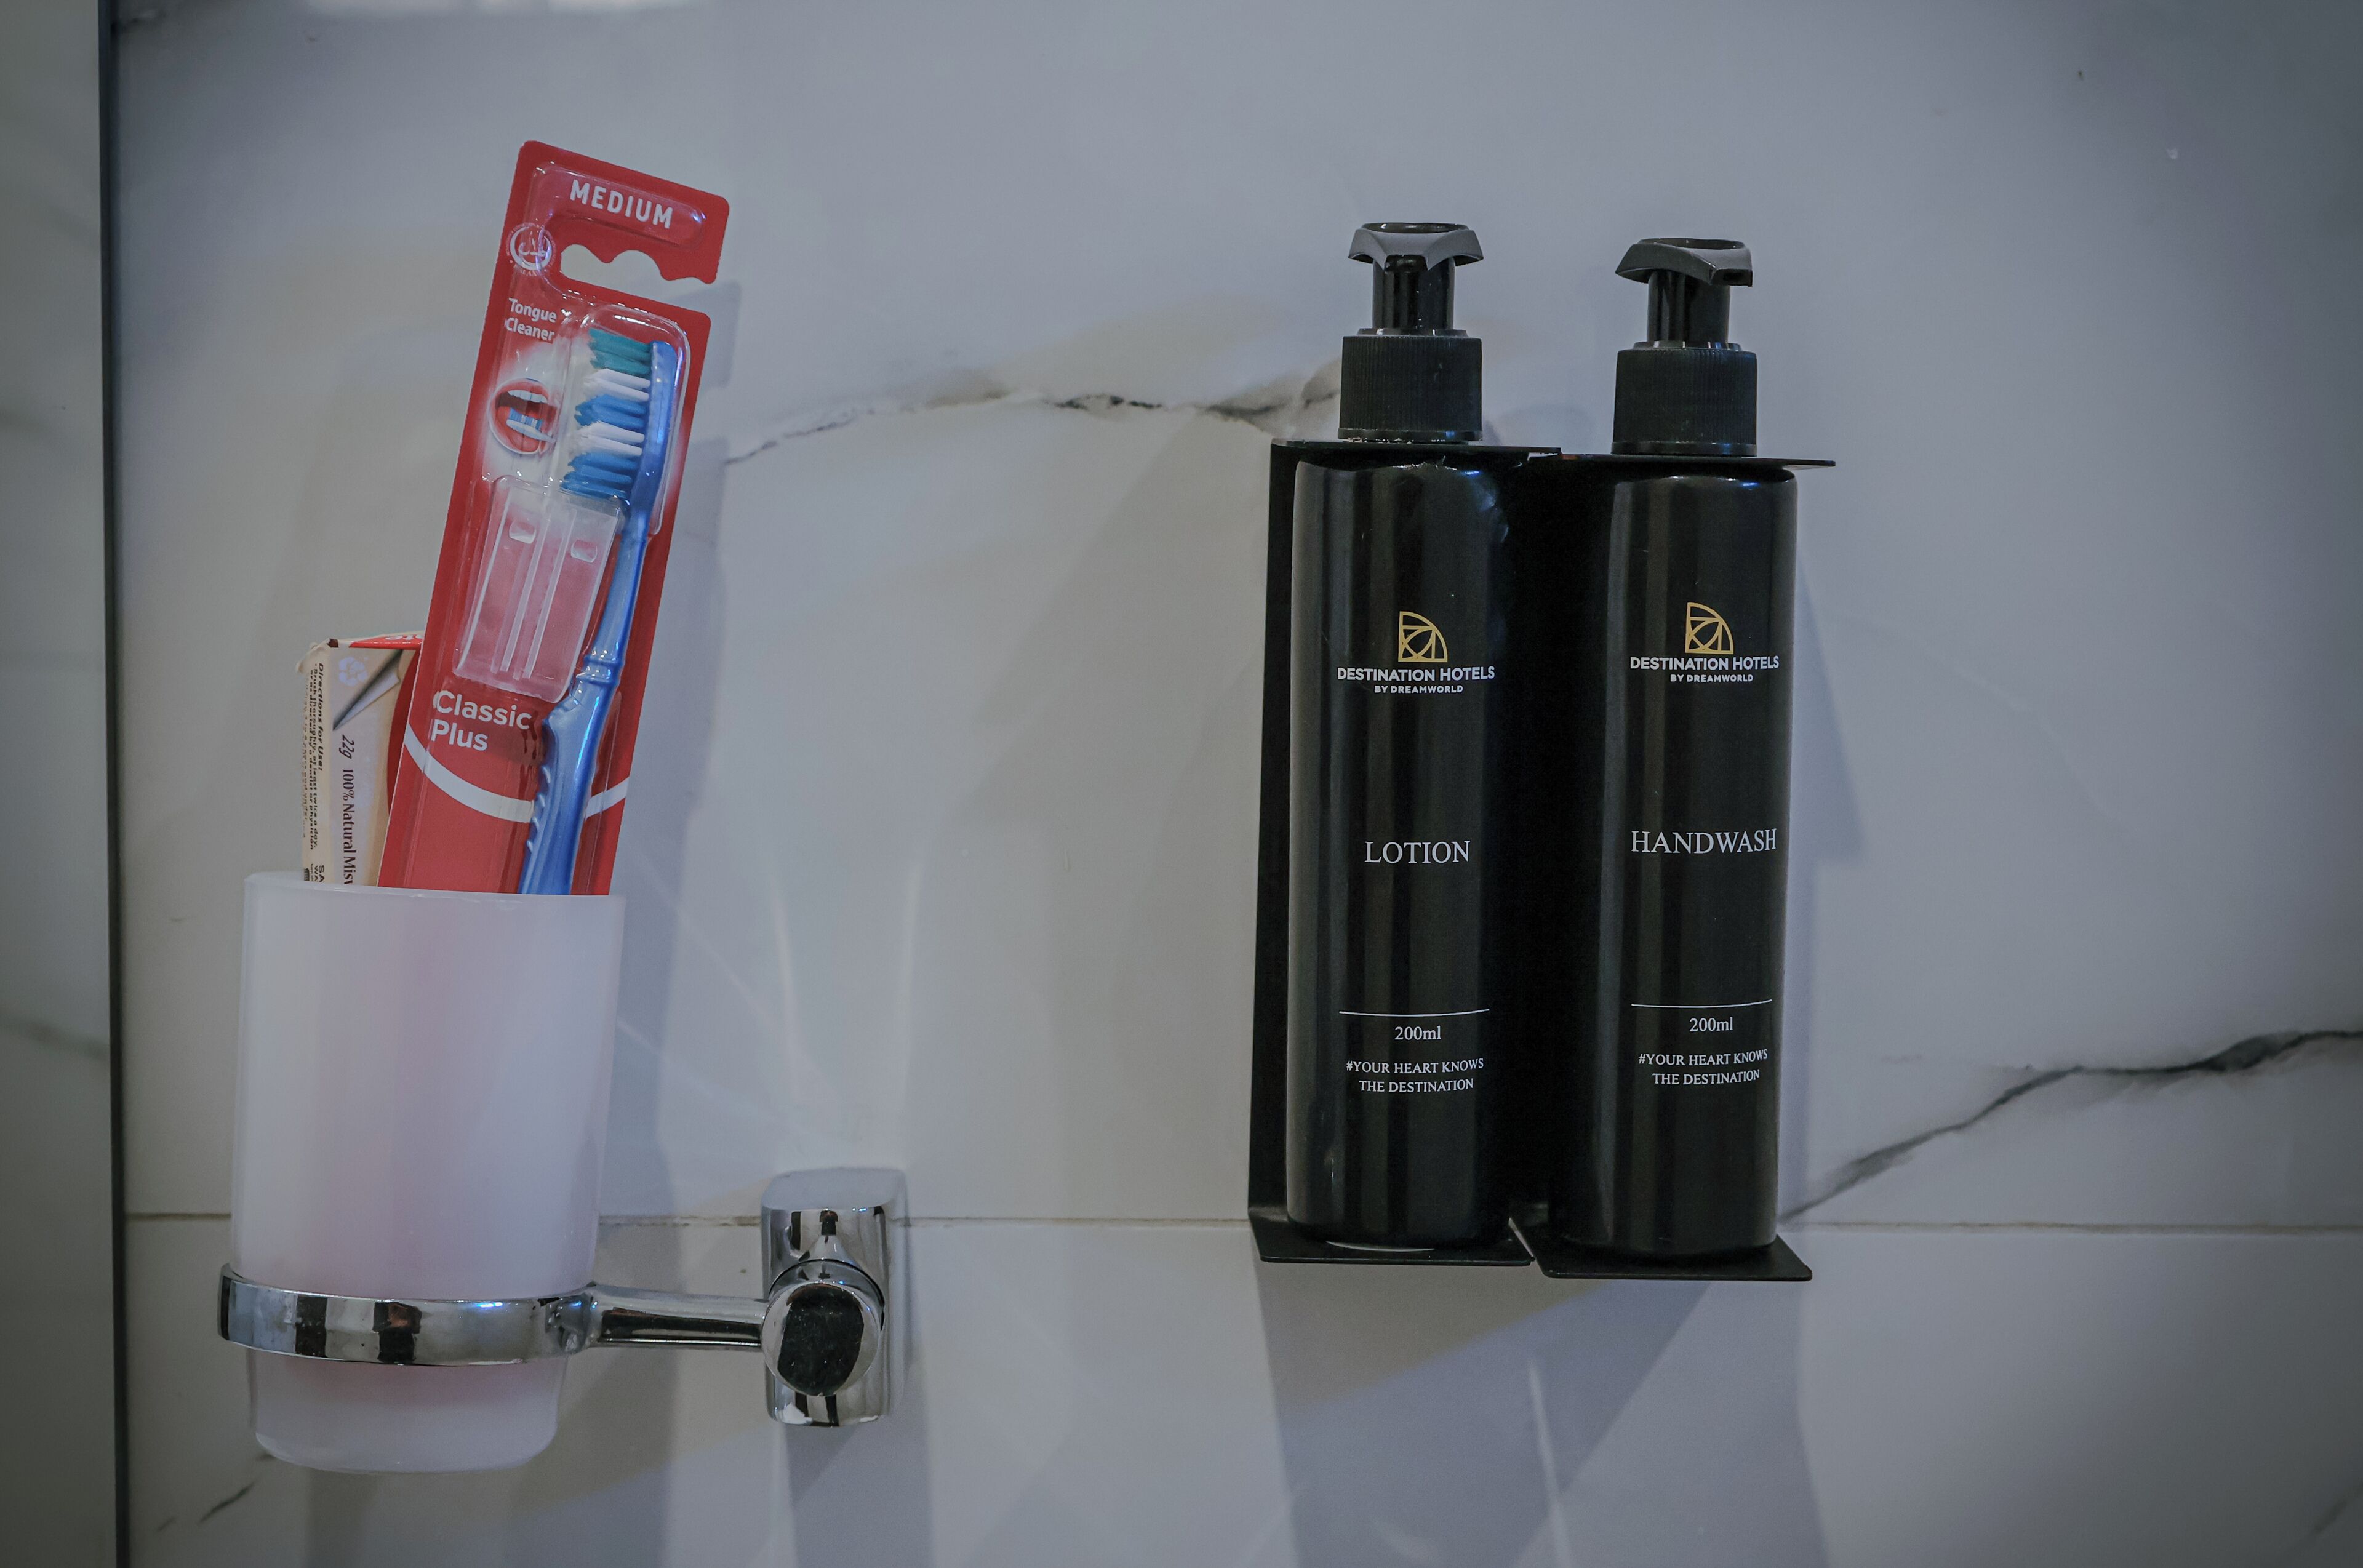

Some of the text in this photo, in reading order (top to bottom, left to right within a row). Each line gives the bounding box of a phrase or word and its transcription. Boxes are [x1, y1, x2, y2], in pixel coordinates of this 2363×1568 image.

[570, 179, 674, 229] MEDIUM
[508, 297, 557, 322] Tongue
[505, 317, 555, 341] Cleaner
[1630, 655, 1780, 670] DESTINATION HOTELS
[1337, 666, 1495, 681] DESTINATION HOTELS
[1670, 674, 1754, 682] BY DREAMWORLD
[1374, 685, 1463, 694] BY DREAMWORLD
[433, 690, 532, 729] Classic
[431, 719, 488, 751] Plus
[338, 734, 354, 759] 22g
[342, 769, 354, 801] 100%
[343, 804, 357, 853] Natural
[1631, 828, 1777, 854] HANDWASH
[1364, 840, 1471, 864] LOTION
[1394, 1025, 1442, 1041] 200ml
[1689, 1017, 1733, 1032] 200ml
[1346, 1058, 1484, 1074] #YOUR HEART KNOWS
[1639, 1049, 1768, 1066] #YOUR HEART KNOWS
[1359, 1078, 1474, 1093] THE DESTINATION
[1652, 1069, 1760, 1085] THE DESTINATION
